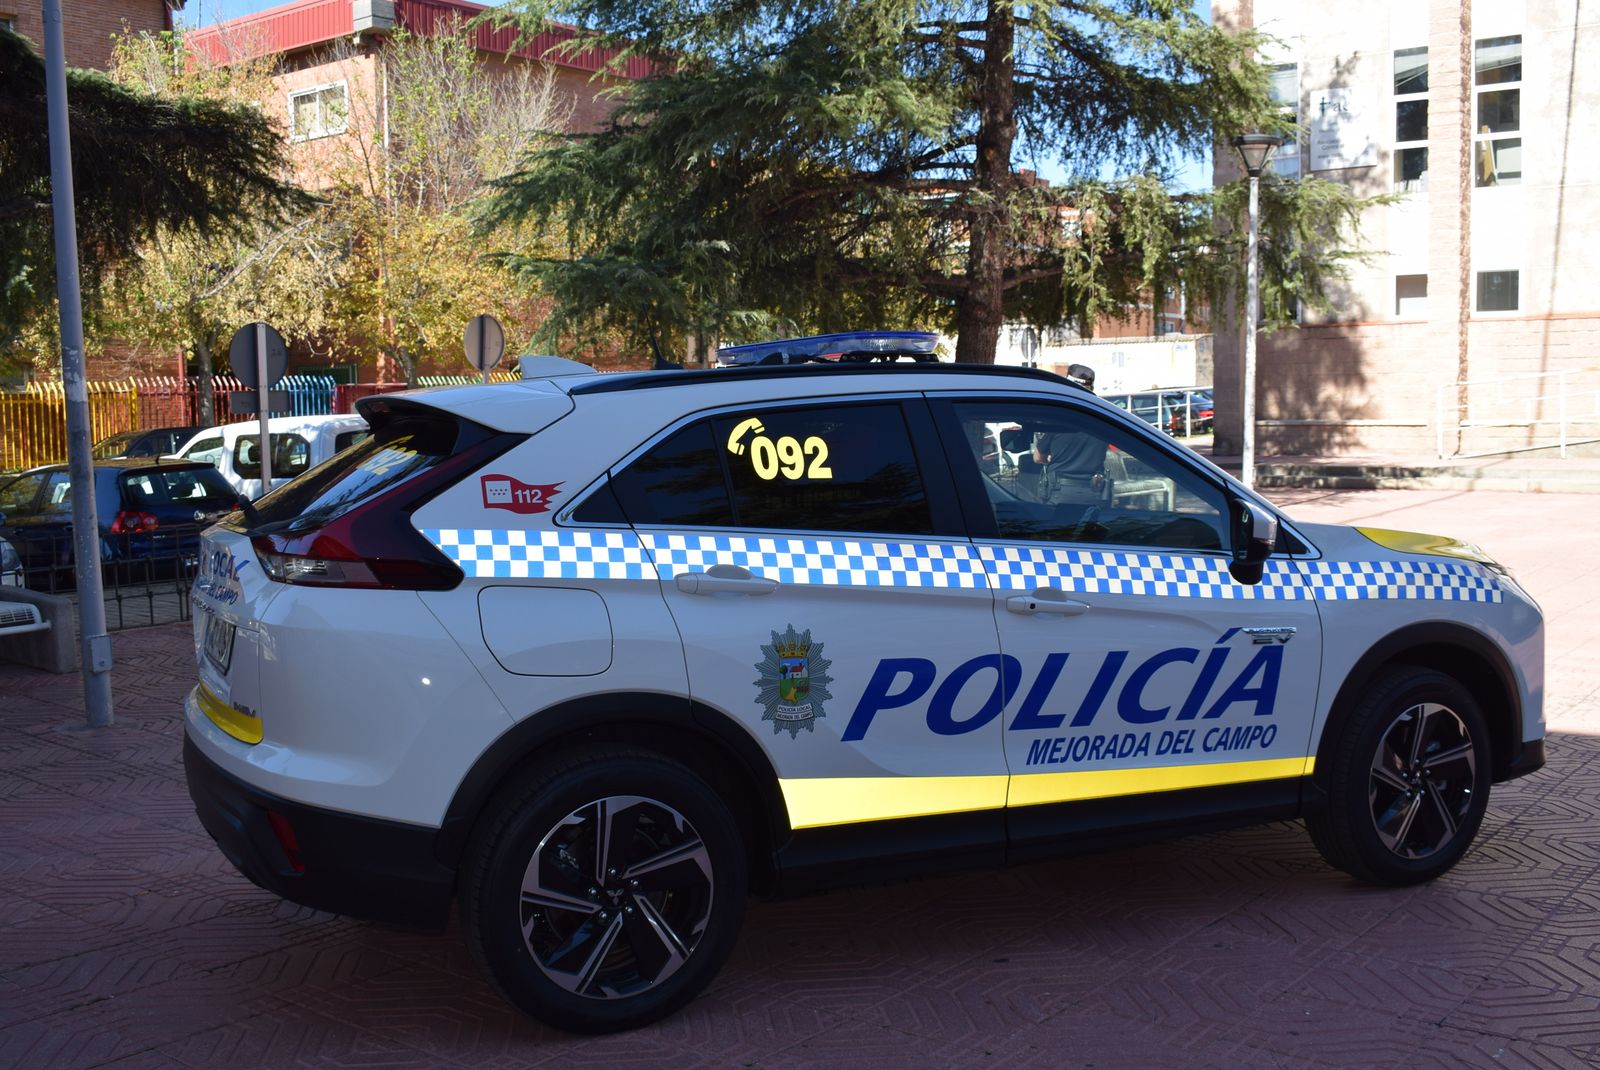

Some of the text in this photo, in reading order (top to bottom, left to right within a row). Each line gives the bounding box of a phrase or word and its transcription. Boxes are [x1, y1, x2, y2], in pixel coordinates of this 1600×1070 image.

[751, 436, 832, 480] 092
[515, 489, 543, 504] 112
[840, 627, 1284, 742] POLICÍA
[1026, 724, 1278, 765] MEJORADA DEL CAMPO
